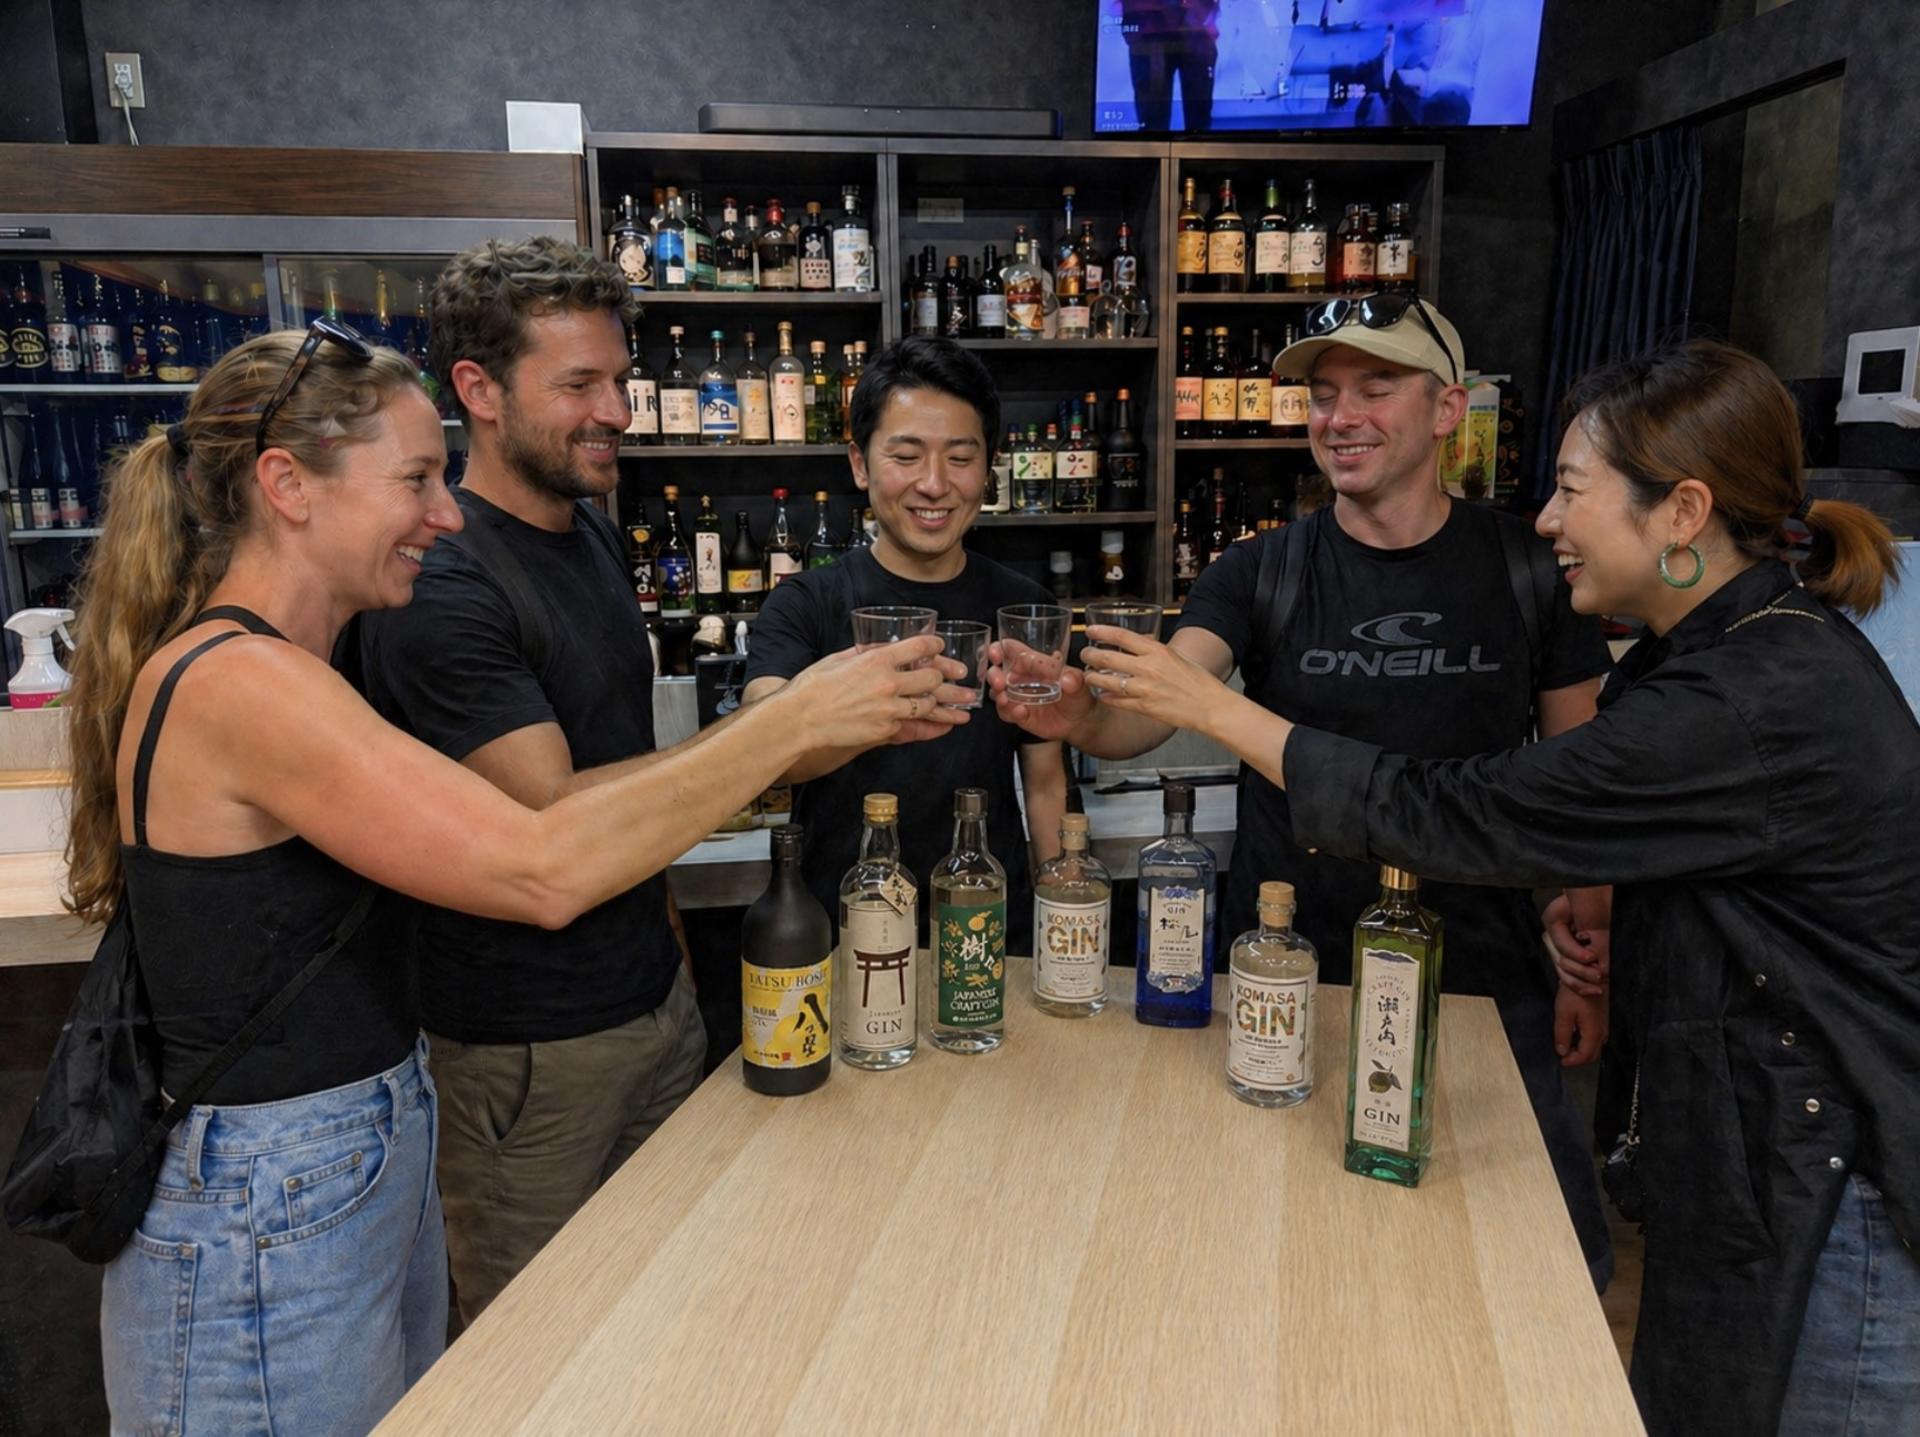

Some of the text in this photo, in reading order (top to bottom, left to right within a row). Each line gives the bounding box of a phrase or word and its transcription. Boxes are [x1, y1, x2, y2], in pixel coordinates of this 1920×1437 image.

[1299, 645, 1501, 677] O'NEILL
[1046, 912, 1101, 926] KOMASA
[1046, 924, 1100, 956] GIN
[1236, 984, 1296, 1005] KOMASA
[866, 1017, 902, 1034] GIN
[1236, 998, 1296, 1037] GIN
[1363, 1107, 1401, 1126] GIN
